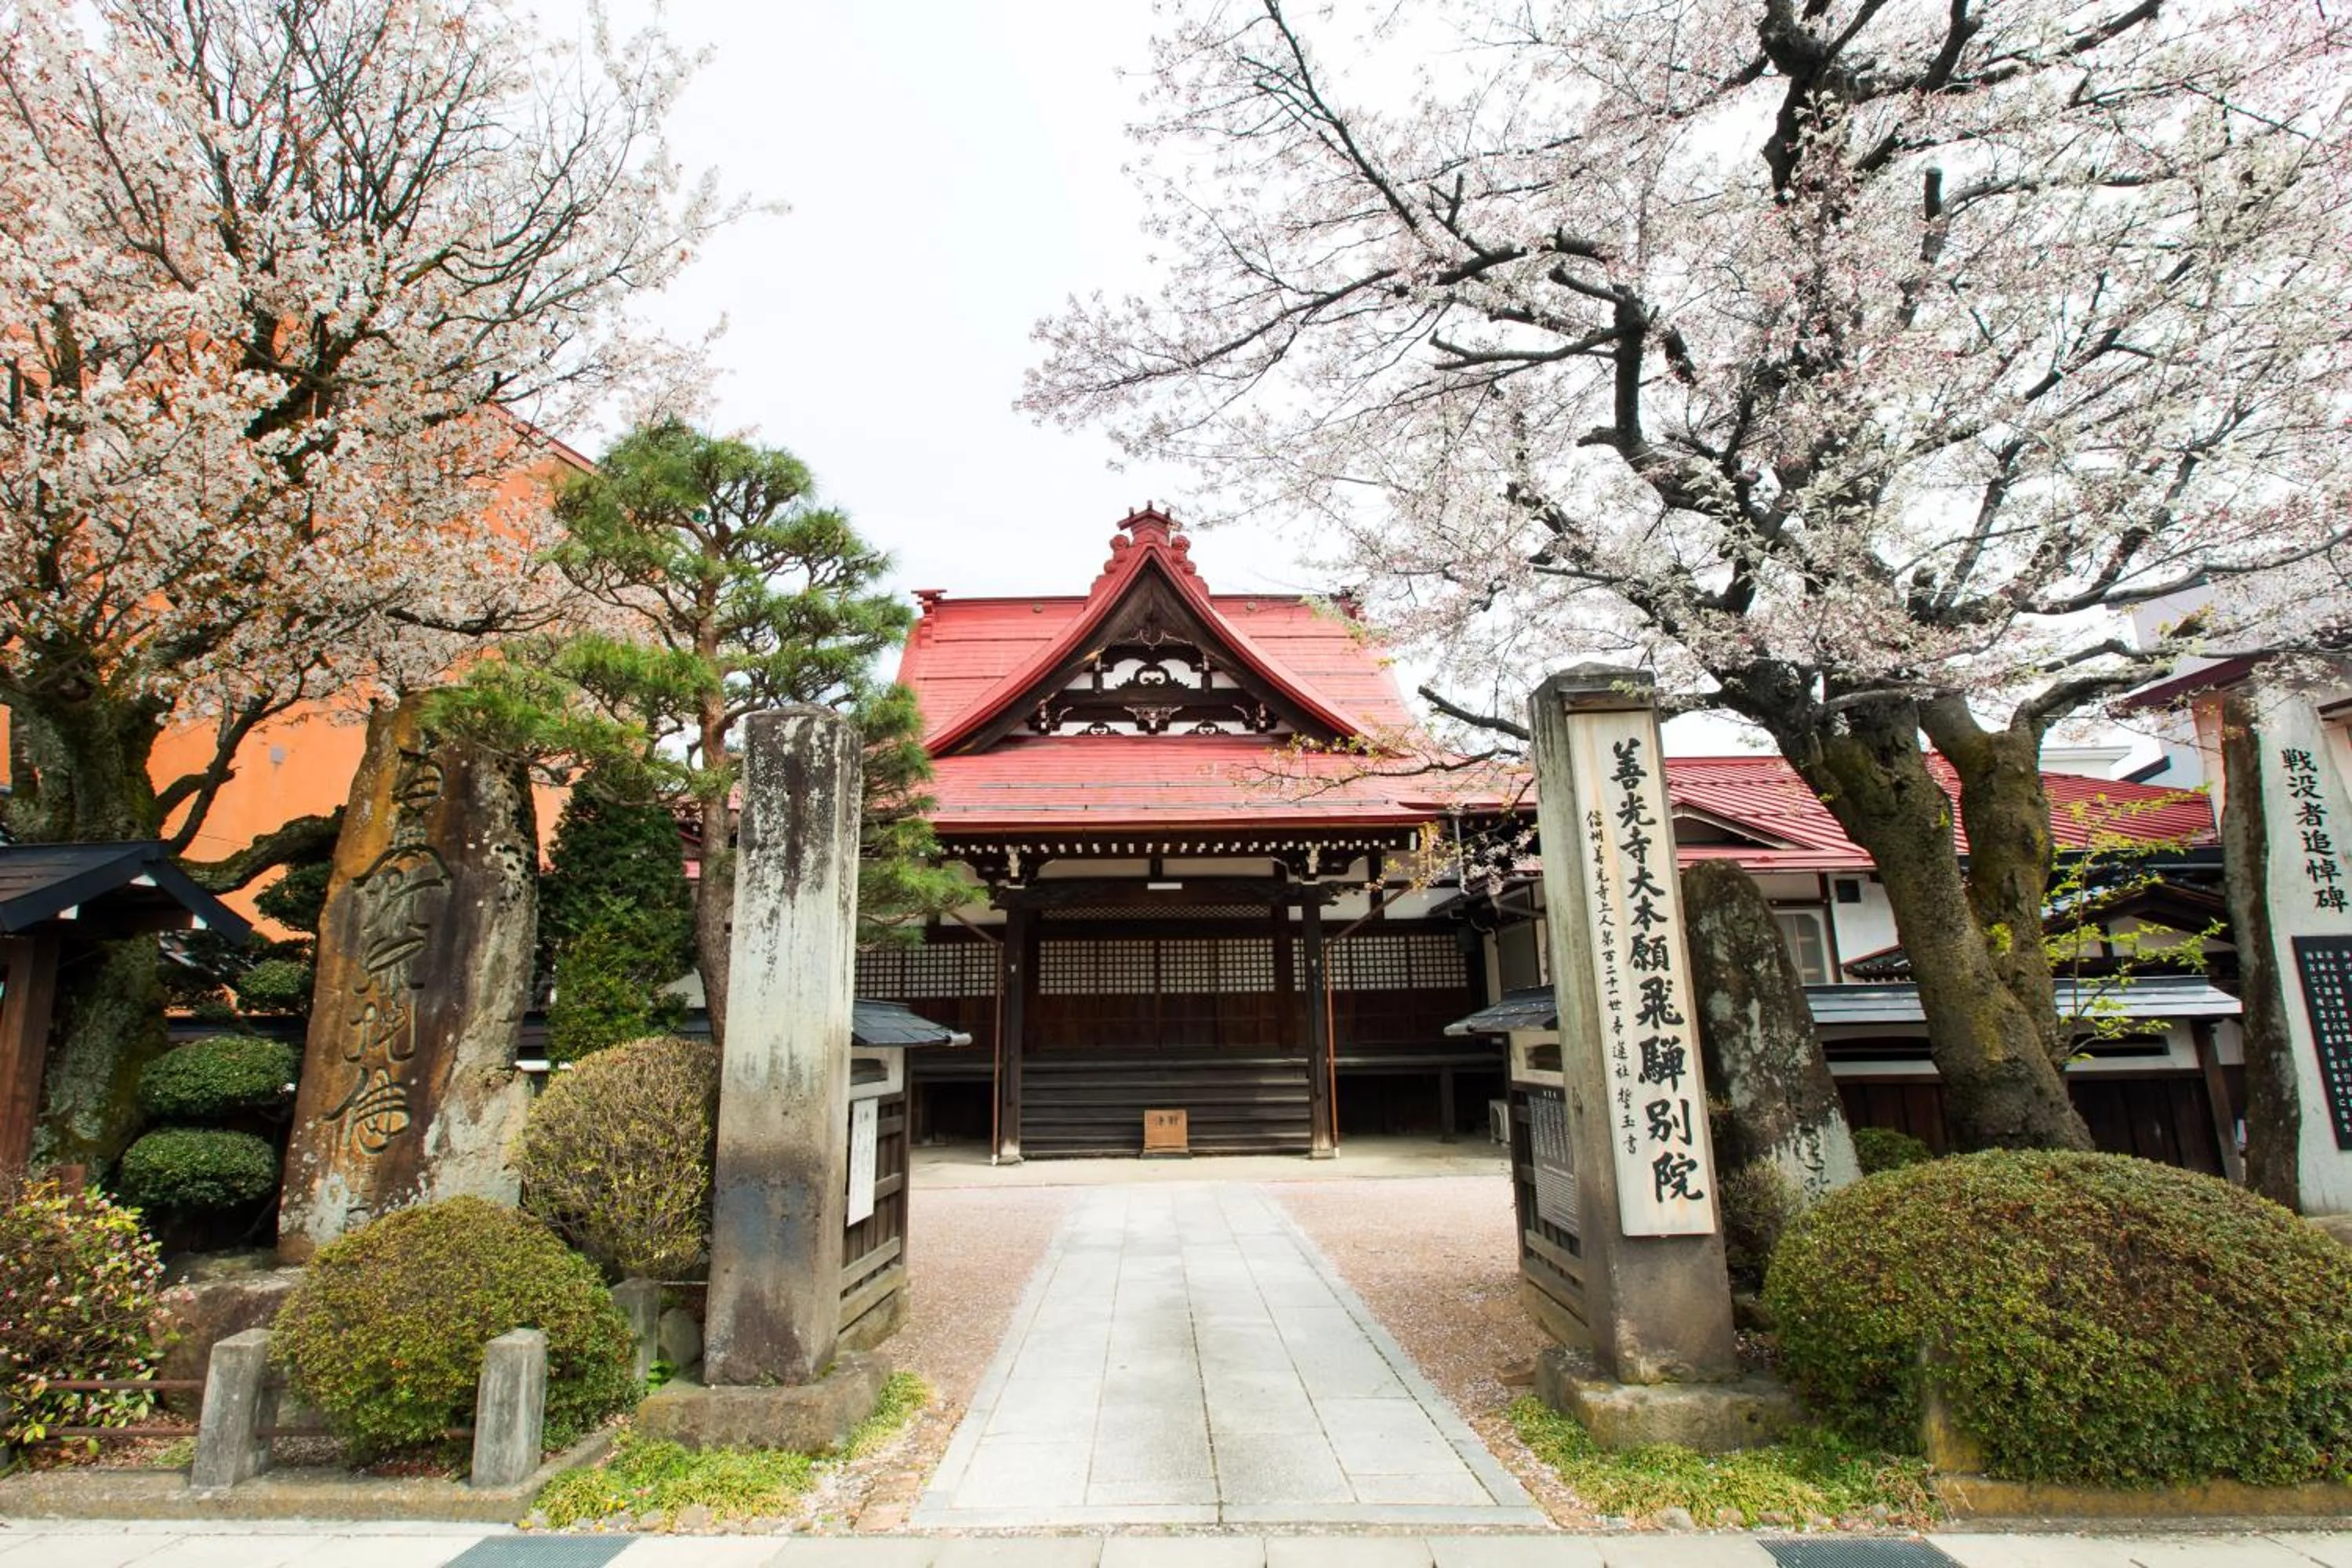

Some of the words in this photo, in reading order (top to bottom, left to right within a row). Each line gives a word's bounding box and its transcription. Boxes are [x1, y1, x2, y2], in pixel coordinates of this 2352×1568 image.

[1610, 737, 1705, 1203] 善光寺大本願飛騨別院
[2281, 748, 2349, 914] 戦没者追悼碑
